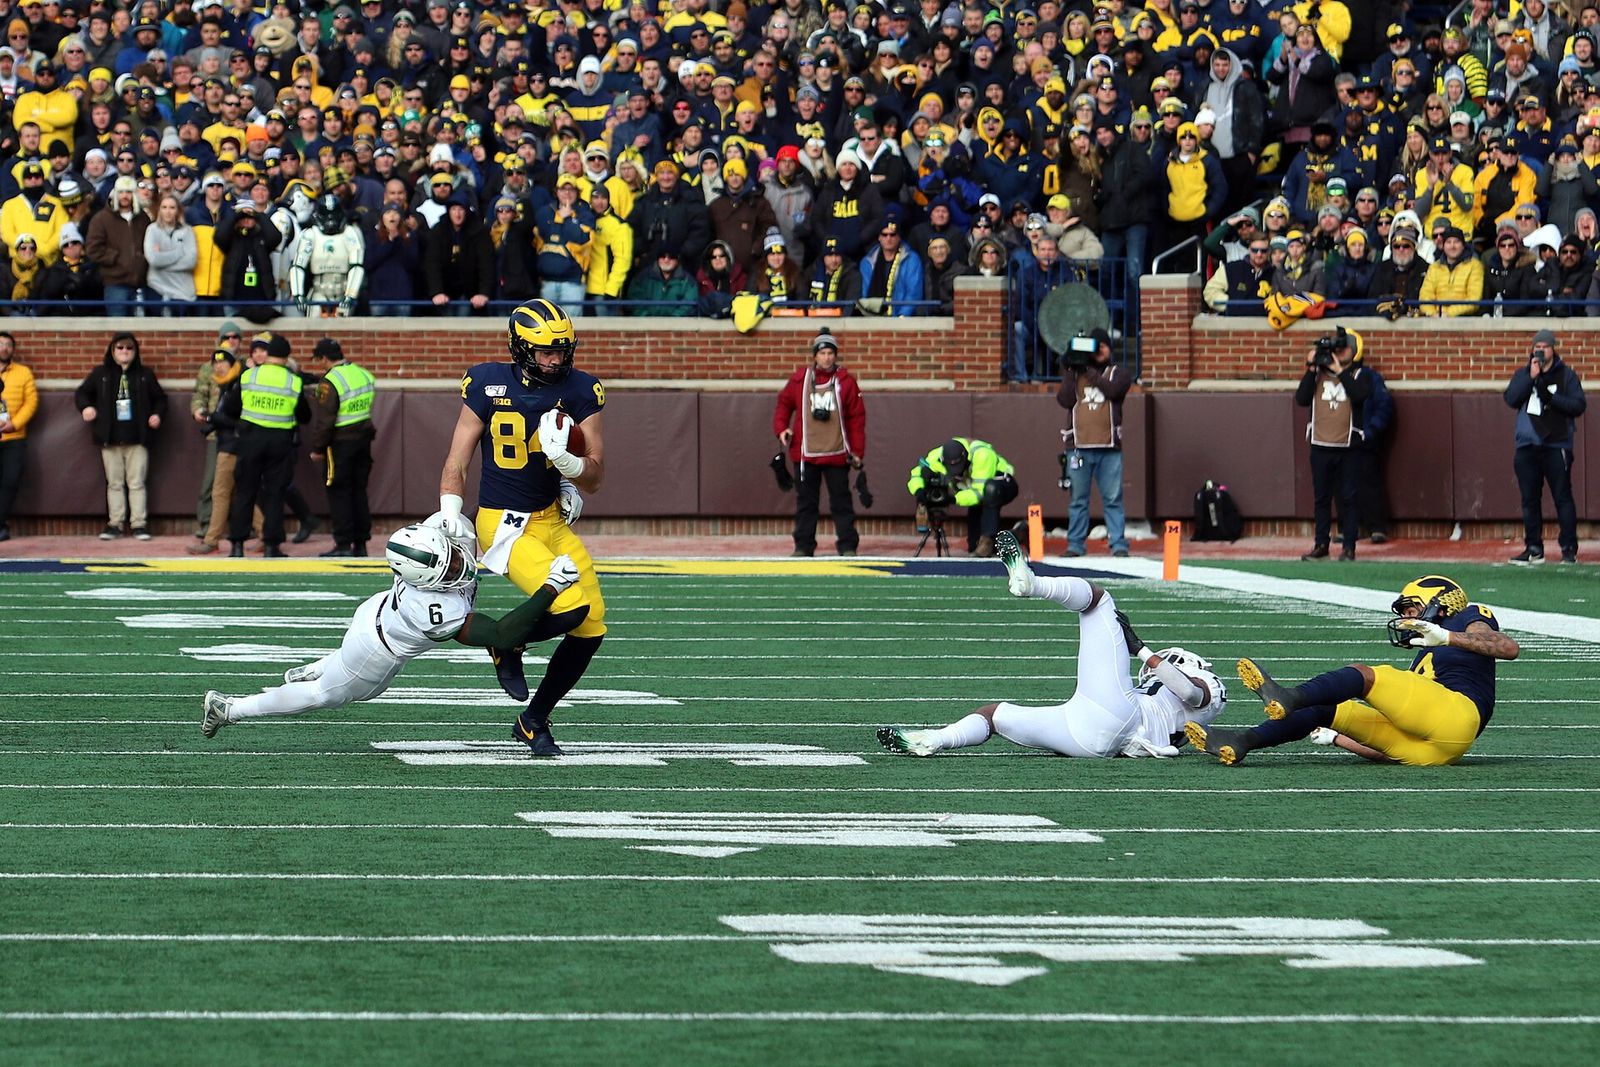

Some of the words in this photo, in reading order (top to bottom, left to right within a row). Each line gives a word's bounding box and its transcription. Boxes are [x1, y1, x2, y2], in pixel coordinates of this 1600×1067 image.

[1361, 144, 1378, 161] M
[1322, 380, 1348, 402] M
[250, 395, 285, 411] SHERIFF
[504, 513, 524, 528] M
[428, 604, 443, 626] 6
